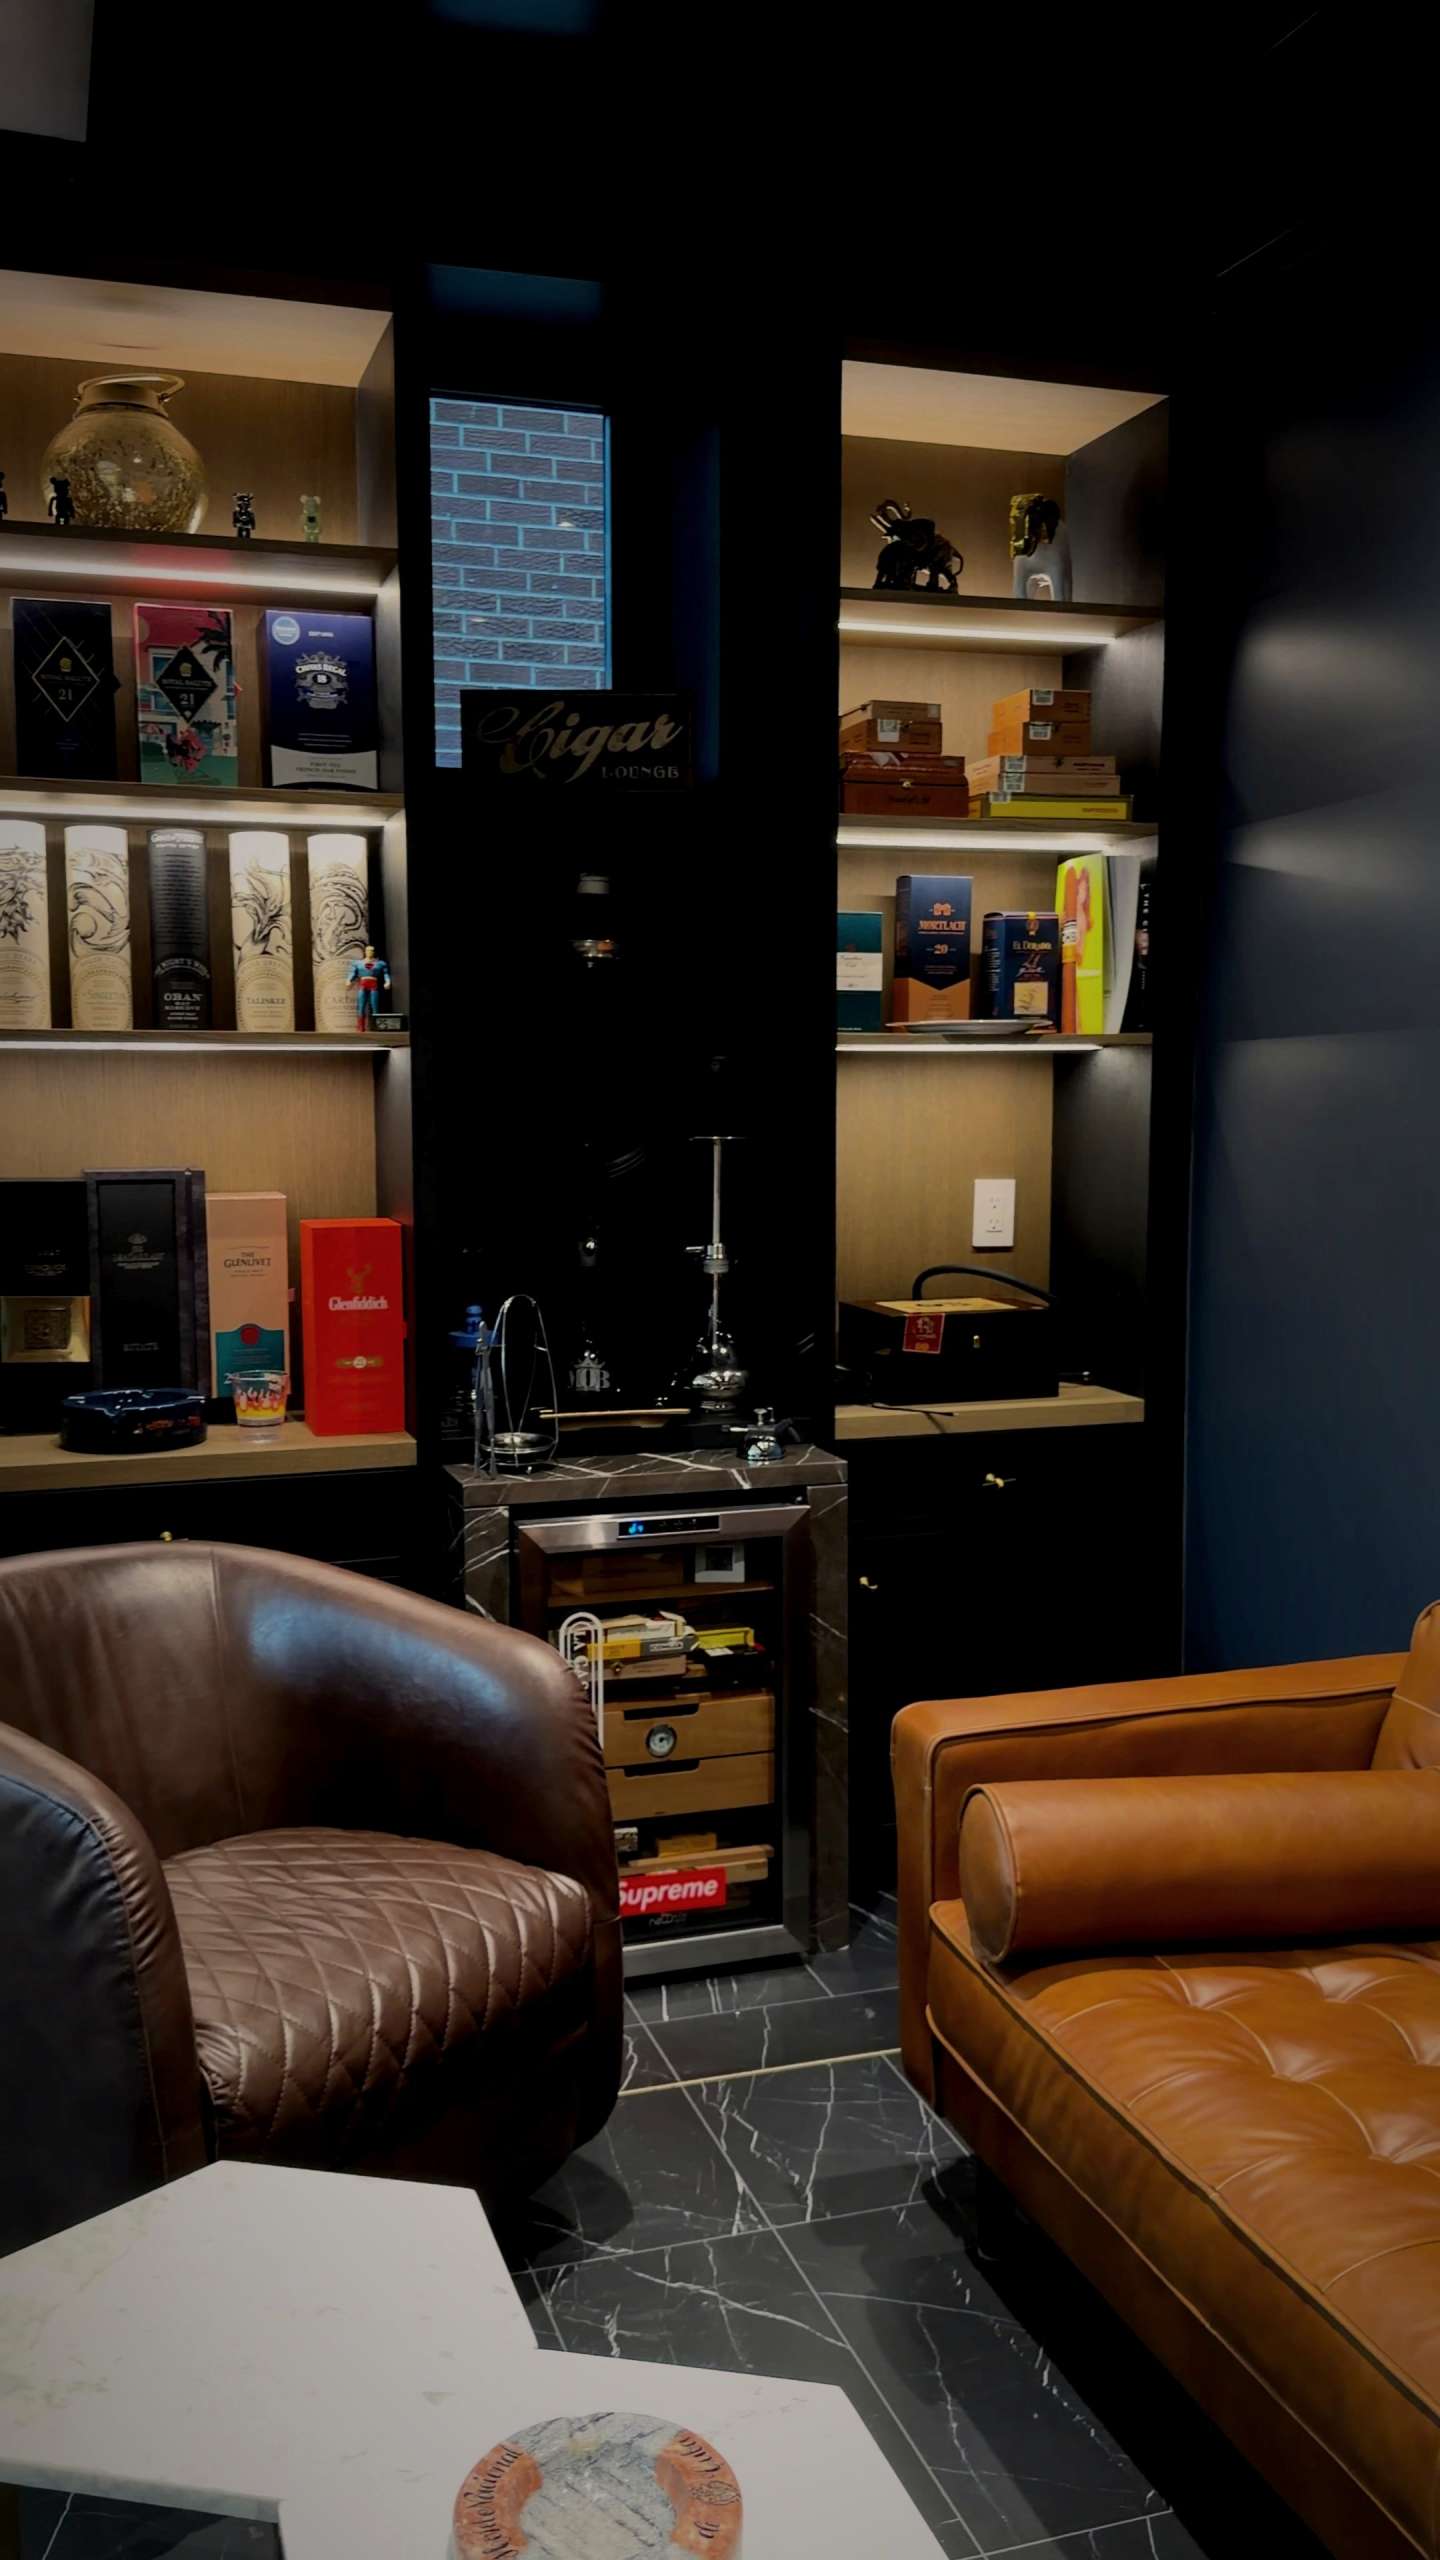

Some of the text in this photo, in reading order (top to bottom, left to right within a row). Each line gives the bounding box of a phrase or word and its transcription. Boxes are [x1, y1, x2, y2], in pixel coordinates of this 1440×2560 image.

[58, 688, 73, 701] 21
[178, 692, 195, 706] 21
[476, 700, 684, 784] Cigar
[601, 764, 680, 779] LOUNGE
[918, 920, 967, 931] MORTLACH
[163, 992, 203, 1001] OBAN
[223, 1257, 271, 1269] GLENLIVET
[328, 1296, 389, 1312] Glenfiddich
